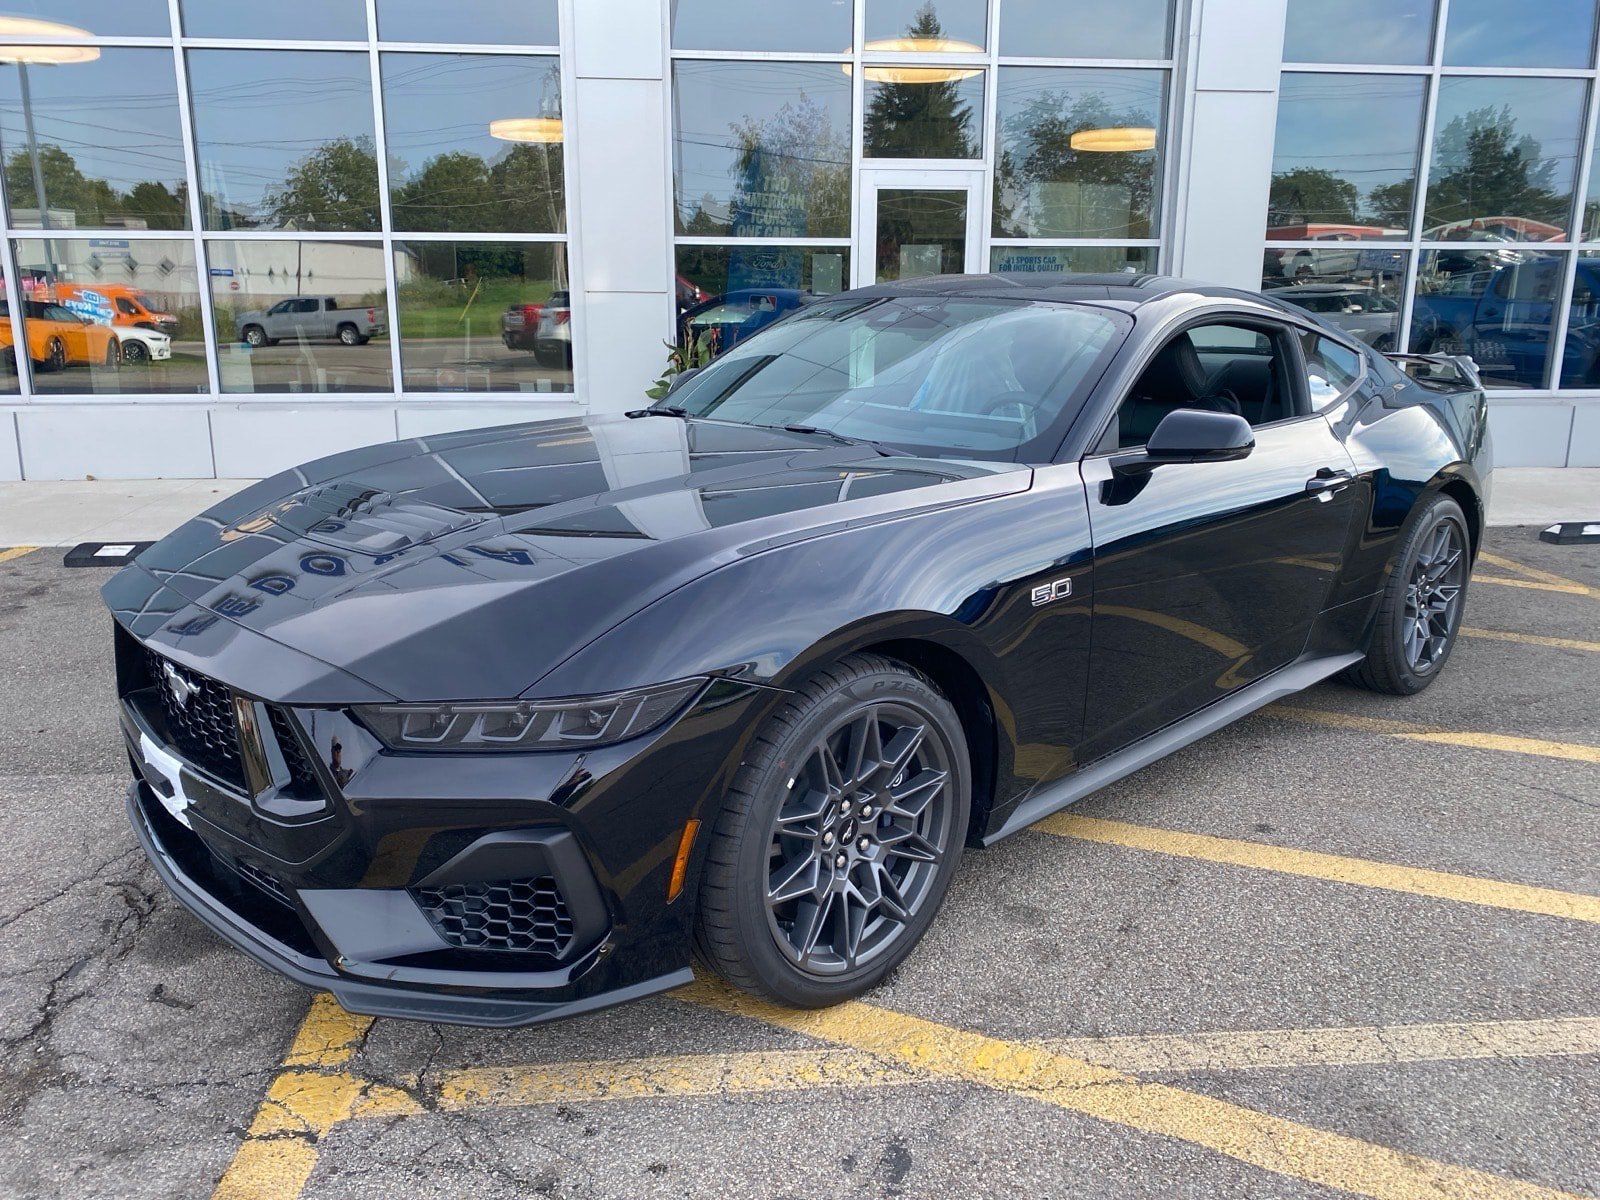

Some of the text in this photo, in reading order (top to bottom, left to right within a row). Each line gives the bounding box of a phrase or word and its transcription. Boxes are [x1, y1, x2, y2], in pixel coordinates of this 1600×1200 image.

[736, 224, 762, 237] ONE
[752, 255, 783, 269] Ford
[1016, 256, 1041, 265] SPORTS
[1043, 256, 1057, 265] CAR
[999, 264, 1065, 272] FOR INITIAL QUALITY
[1031, 577, 1072, 607] 5.0
[872, 680, 885, 692] P
